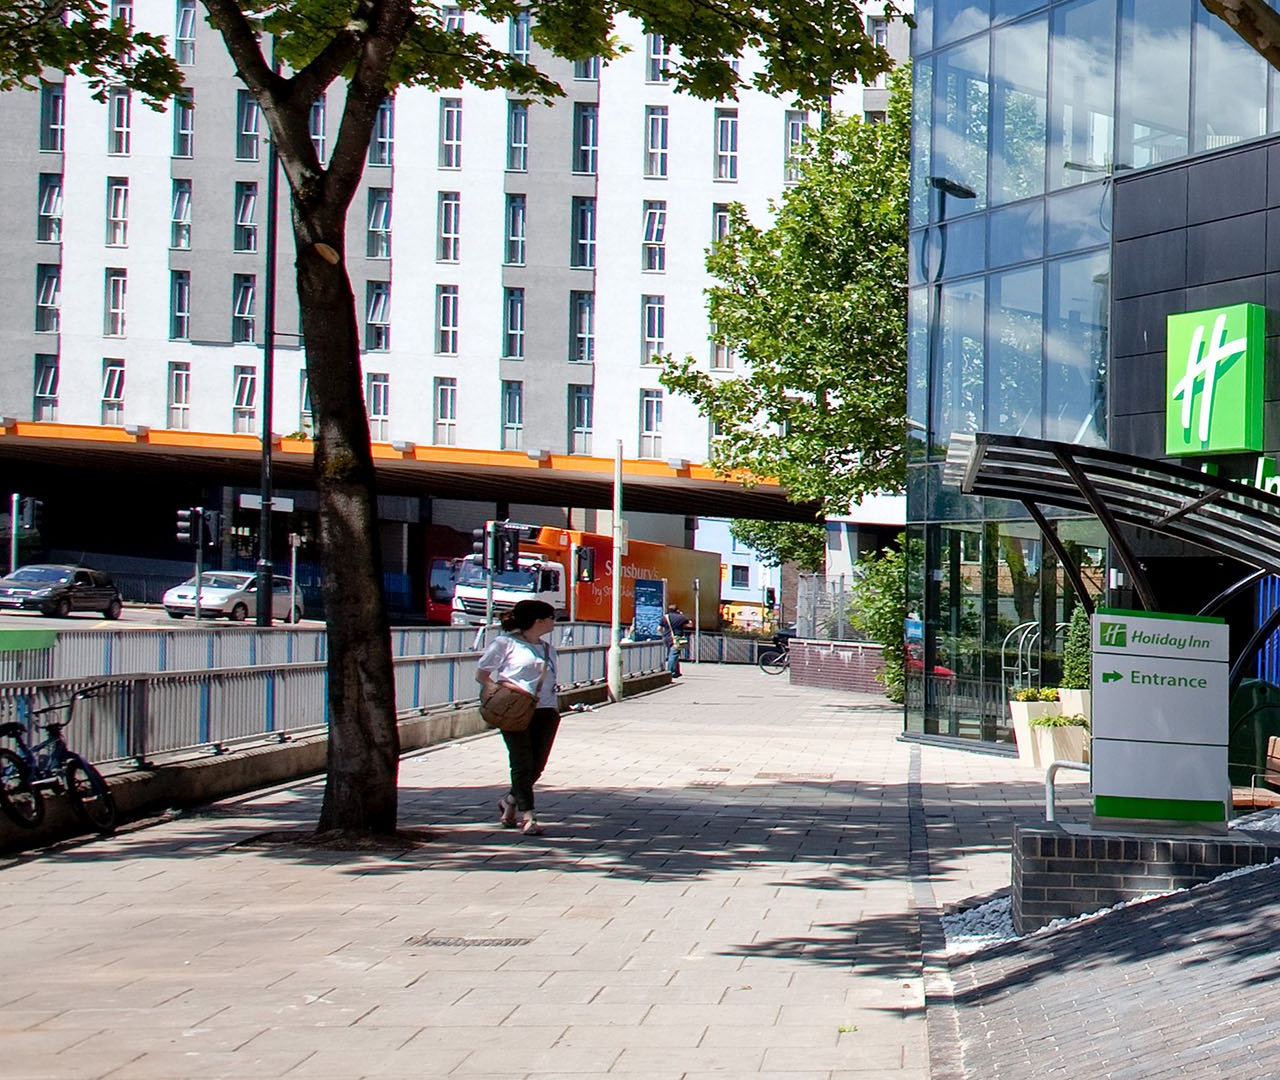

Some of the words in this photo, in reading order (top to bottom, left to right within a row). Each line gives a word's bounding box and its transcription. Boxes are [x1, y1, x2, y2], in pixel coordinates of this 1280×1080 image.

[605, 560, 660, 580] Snsbury's
[1131, 630, 1187, 650] Holiday
[1188, 635, 1211, 649] Inn
[1131, 670, 1208, 689] Entrance
